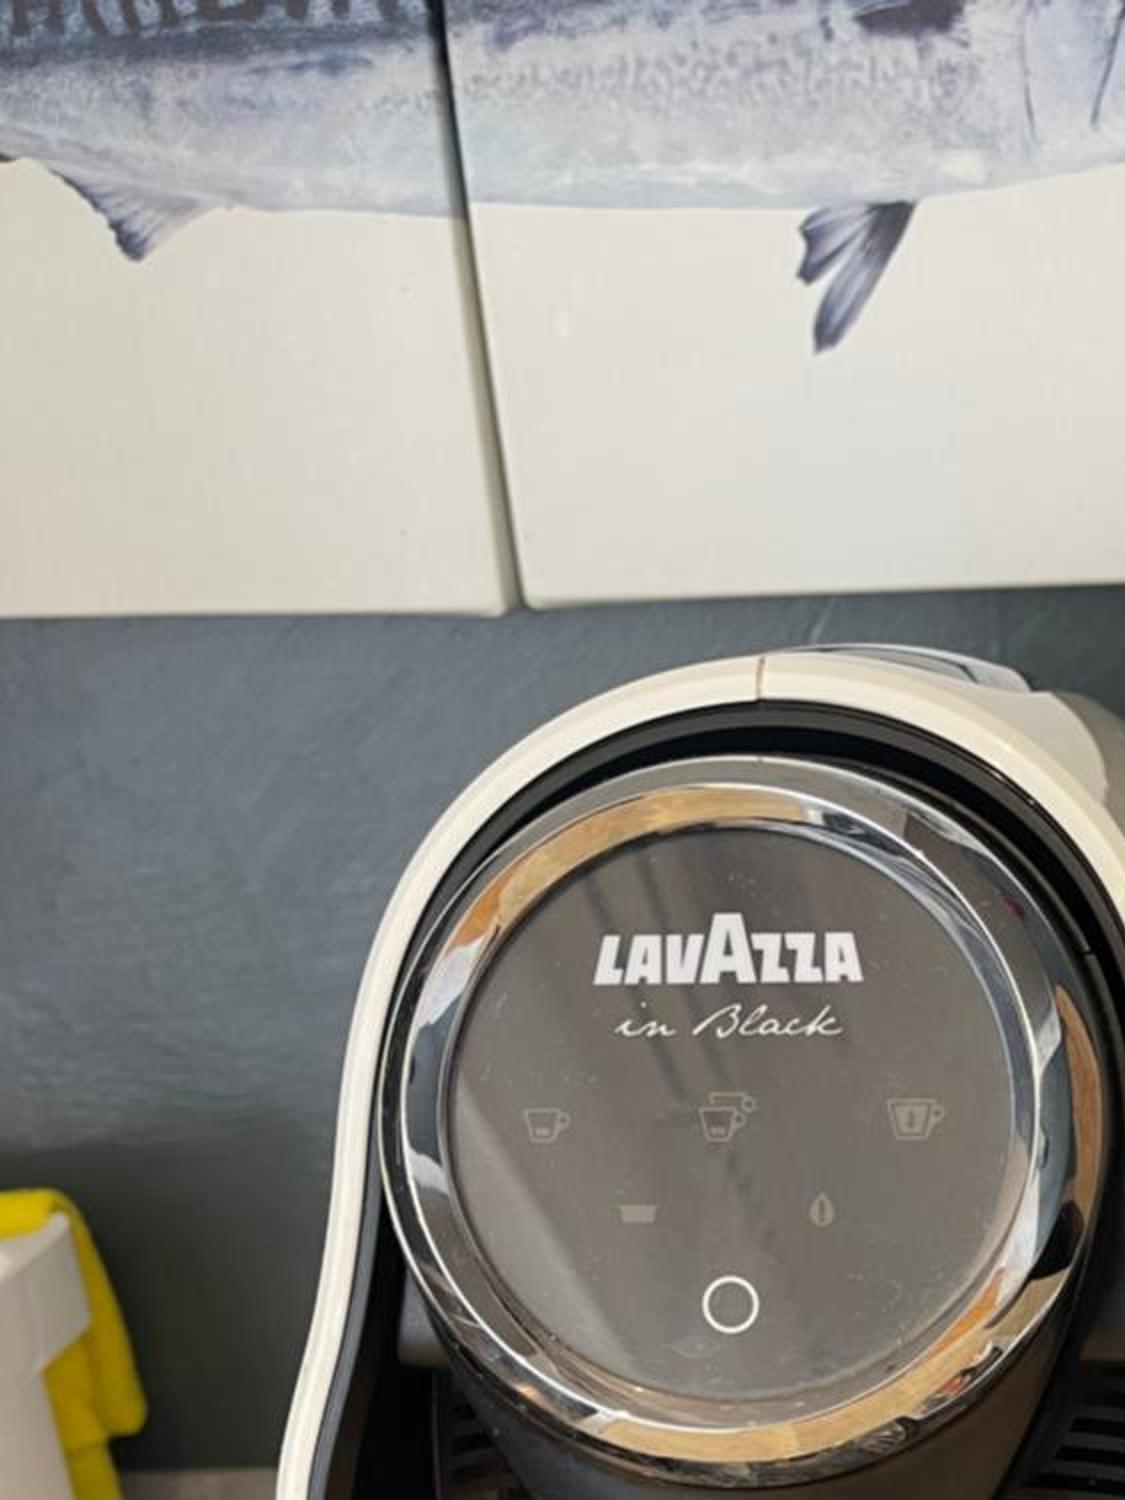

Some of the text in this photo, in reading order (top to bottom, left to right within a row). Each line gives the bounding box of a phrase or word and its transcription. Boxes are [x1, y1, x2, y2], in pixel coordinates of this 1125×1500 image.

[593, 913, 864, 986] LAVAZZA
[614, 1001, 844, 1039] in Black
